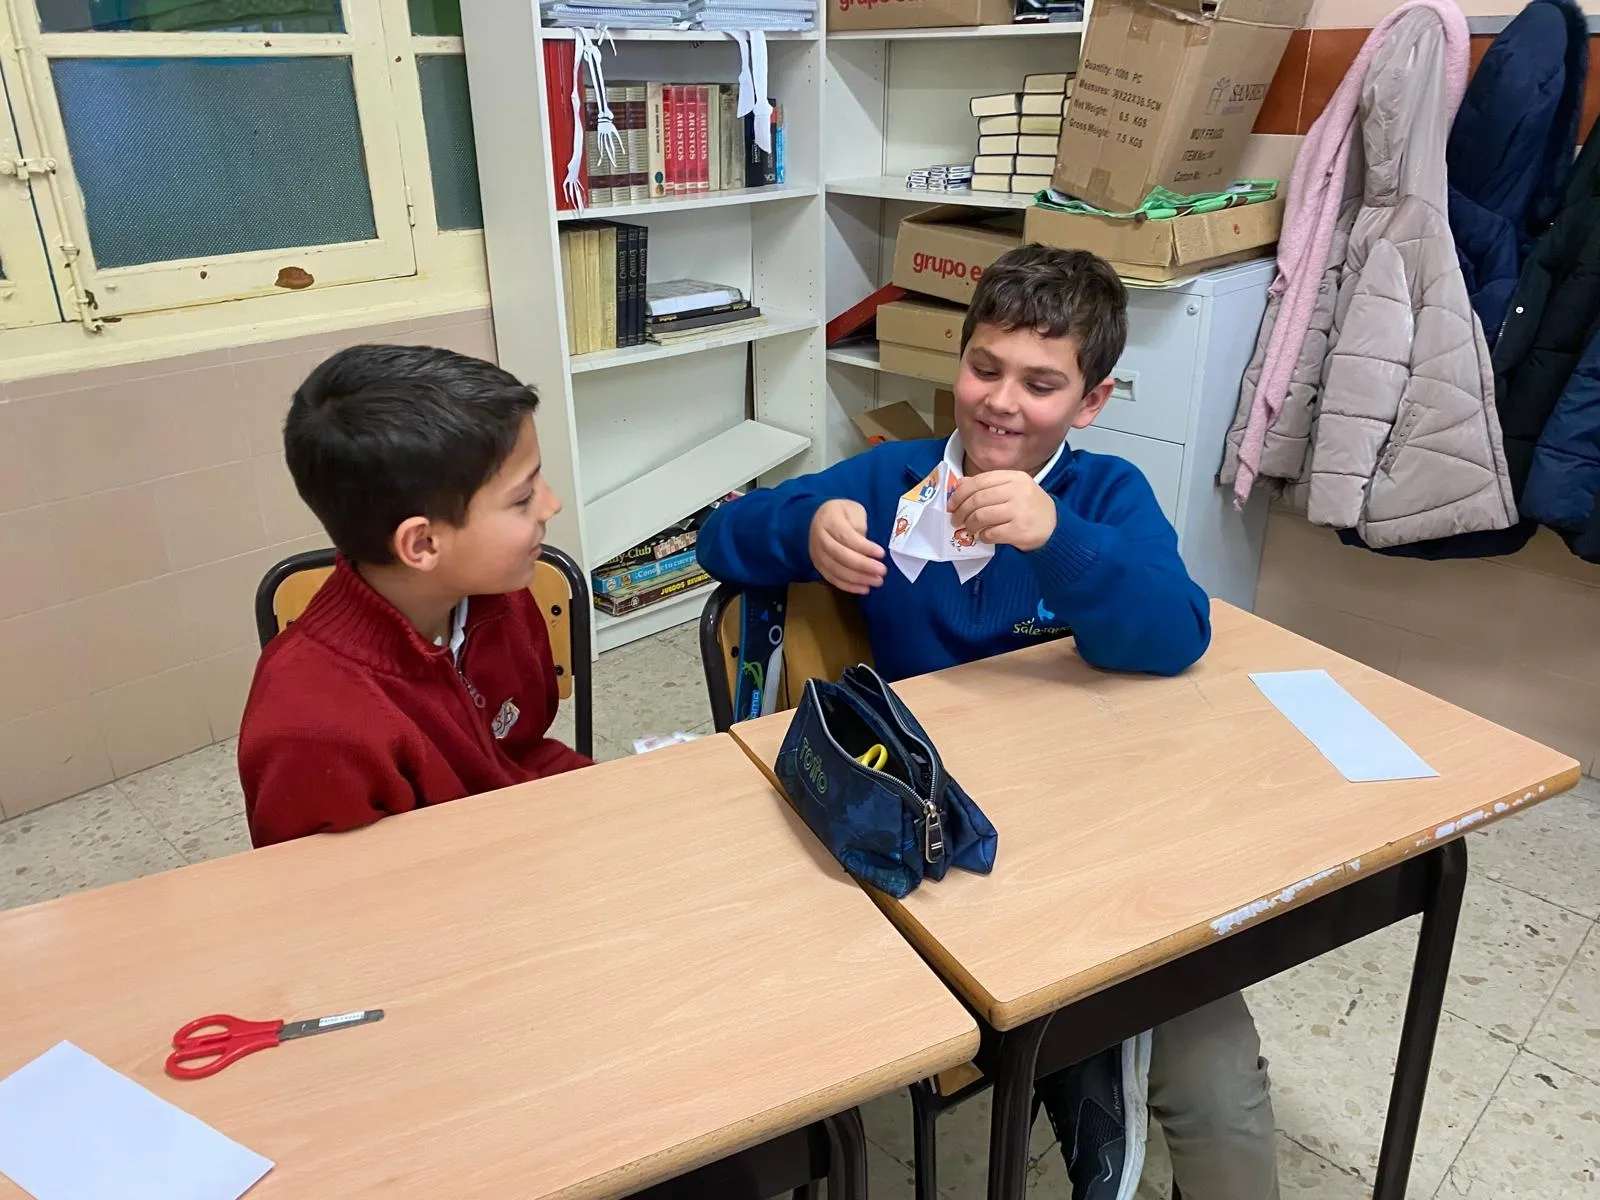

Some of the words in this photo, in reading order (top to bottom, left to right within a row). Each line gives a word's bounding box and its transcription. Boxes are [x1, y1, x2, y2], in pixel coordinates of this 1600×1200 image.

[663, 111, 672, 160] ARISTOS
[676, 112, 685, 161] ARISTOS
[688, 111, 697, 160] ARISTOS
[700, 111, 708, 160] ARISTOS
[1069, 118, 1087, 131] Gross
[1133, 116, 1148, 128] KGS
[1129, 137, 1143, 148] KGS
[912, 252, 967, 279] grupo
[970, 265, 985, 282] e
[661, 581, 685, 596] JUEGOS
